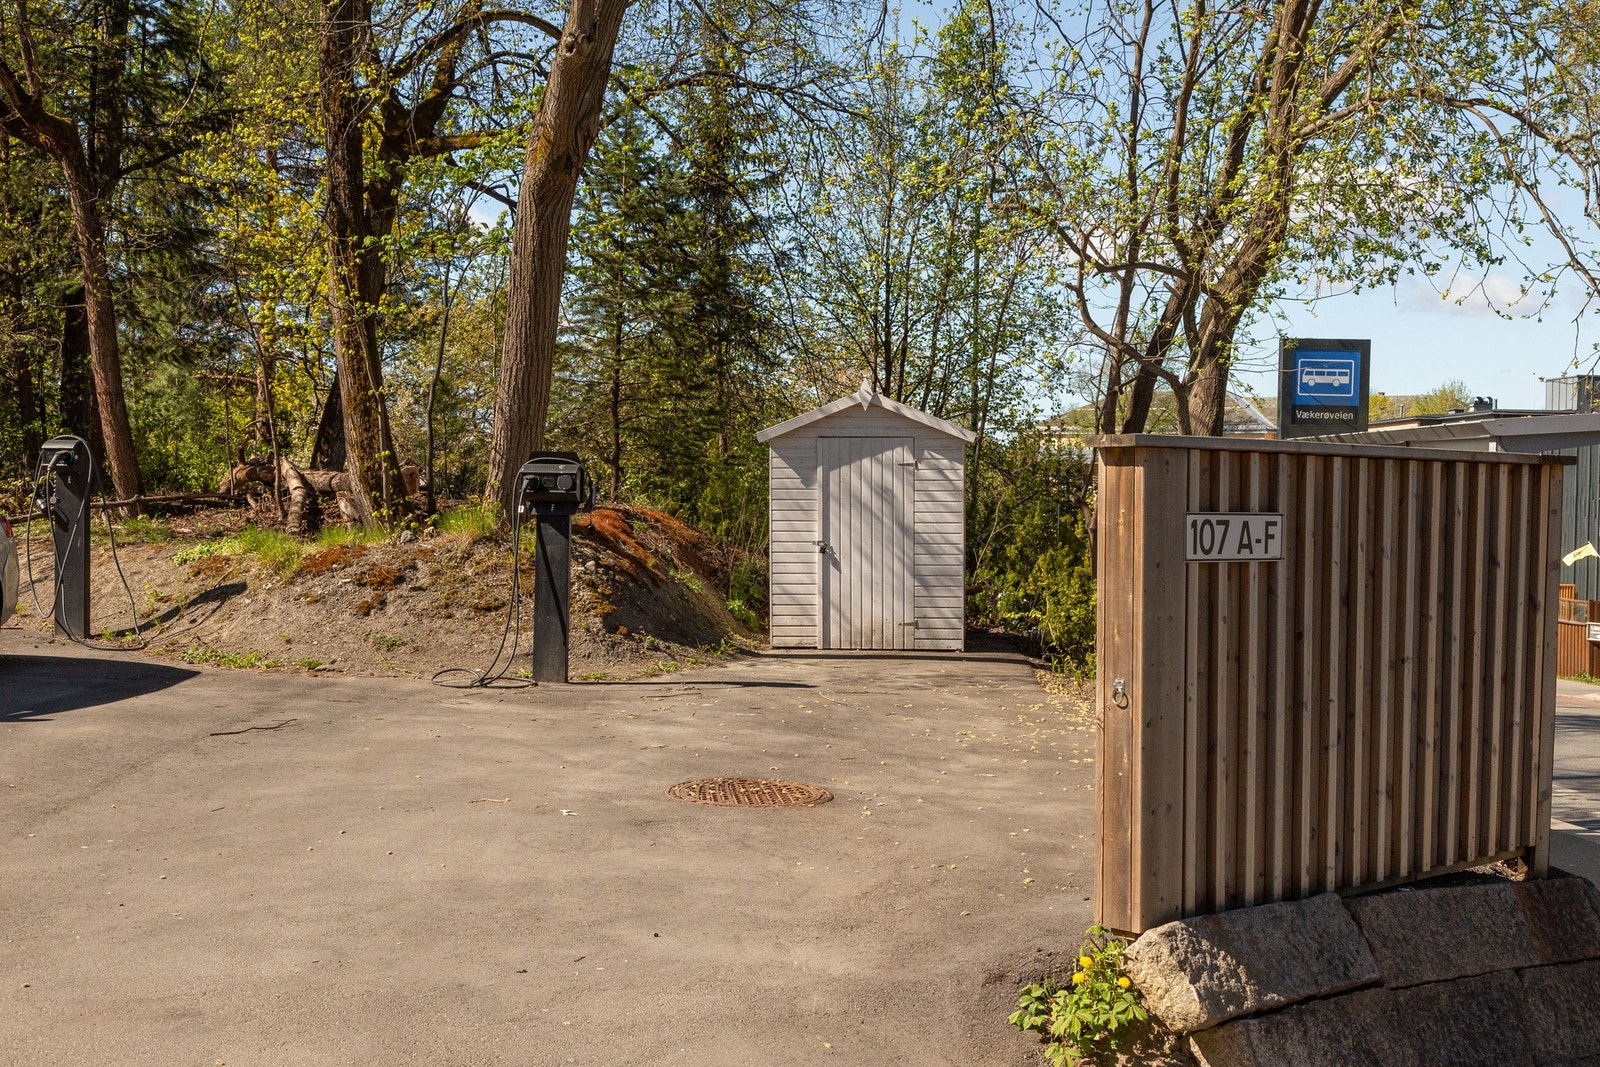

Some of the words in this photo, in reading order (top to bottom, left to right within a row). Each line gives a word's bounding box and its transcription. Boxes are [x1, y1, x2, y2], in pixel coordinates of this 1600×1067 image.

[1296, 410, 1354, 420] Vækerøveien
[1191, 519, 1230, 555] 107
[1237, 520, 1278, 554] A-F
